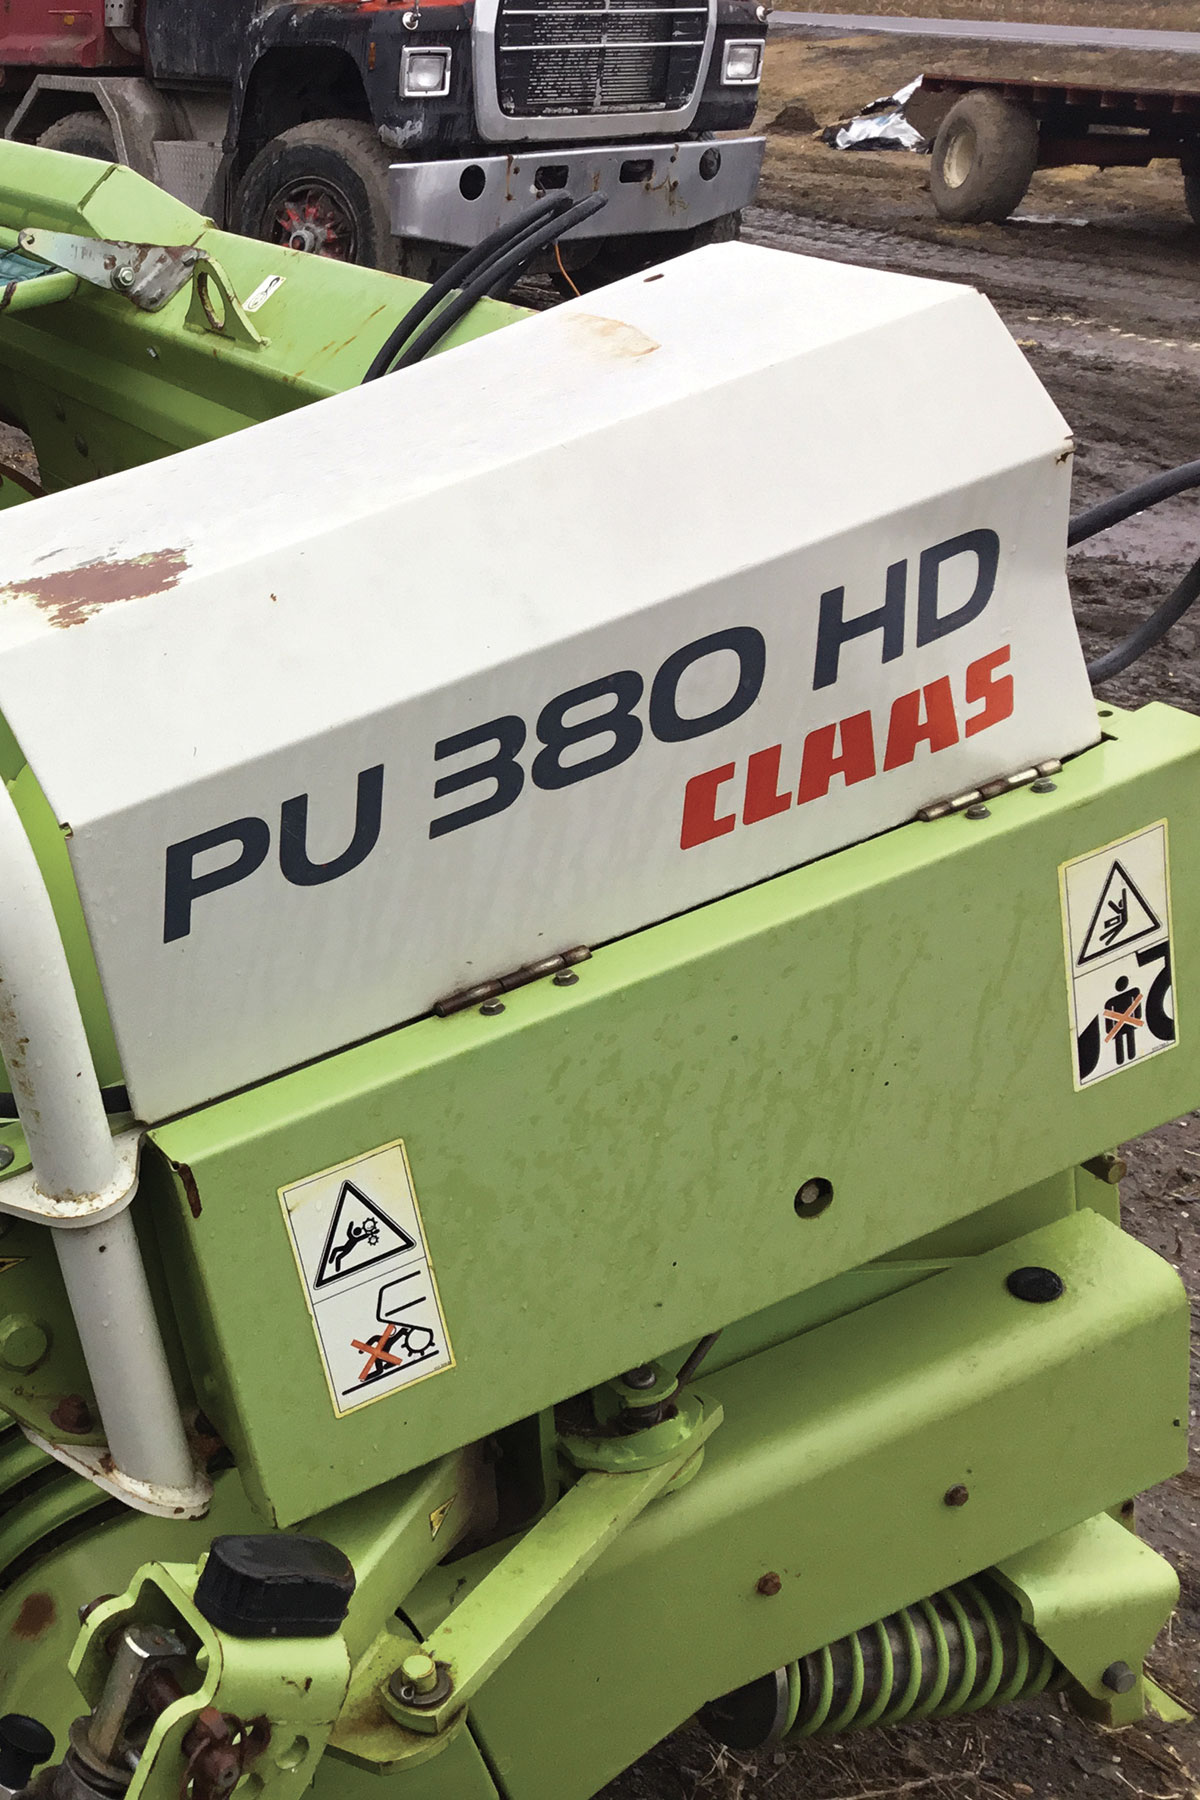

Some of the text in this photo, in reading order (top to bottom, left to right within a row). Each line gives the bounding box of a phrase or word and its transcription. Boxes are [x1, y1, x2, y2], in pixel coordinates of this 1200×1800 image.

[163, 528, 1001, 944] PU 380 HD
[680, 644, 1015, 849] CLAAS
